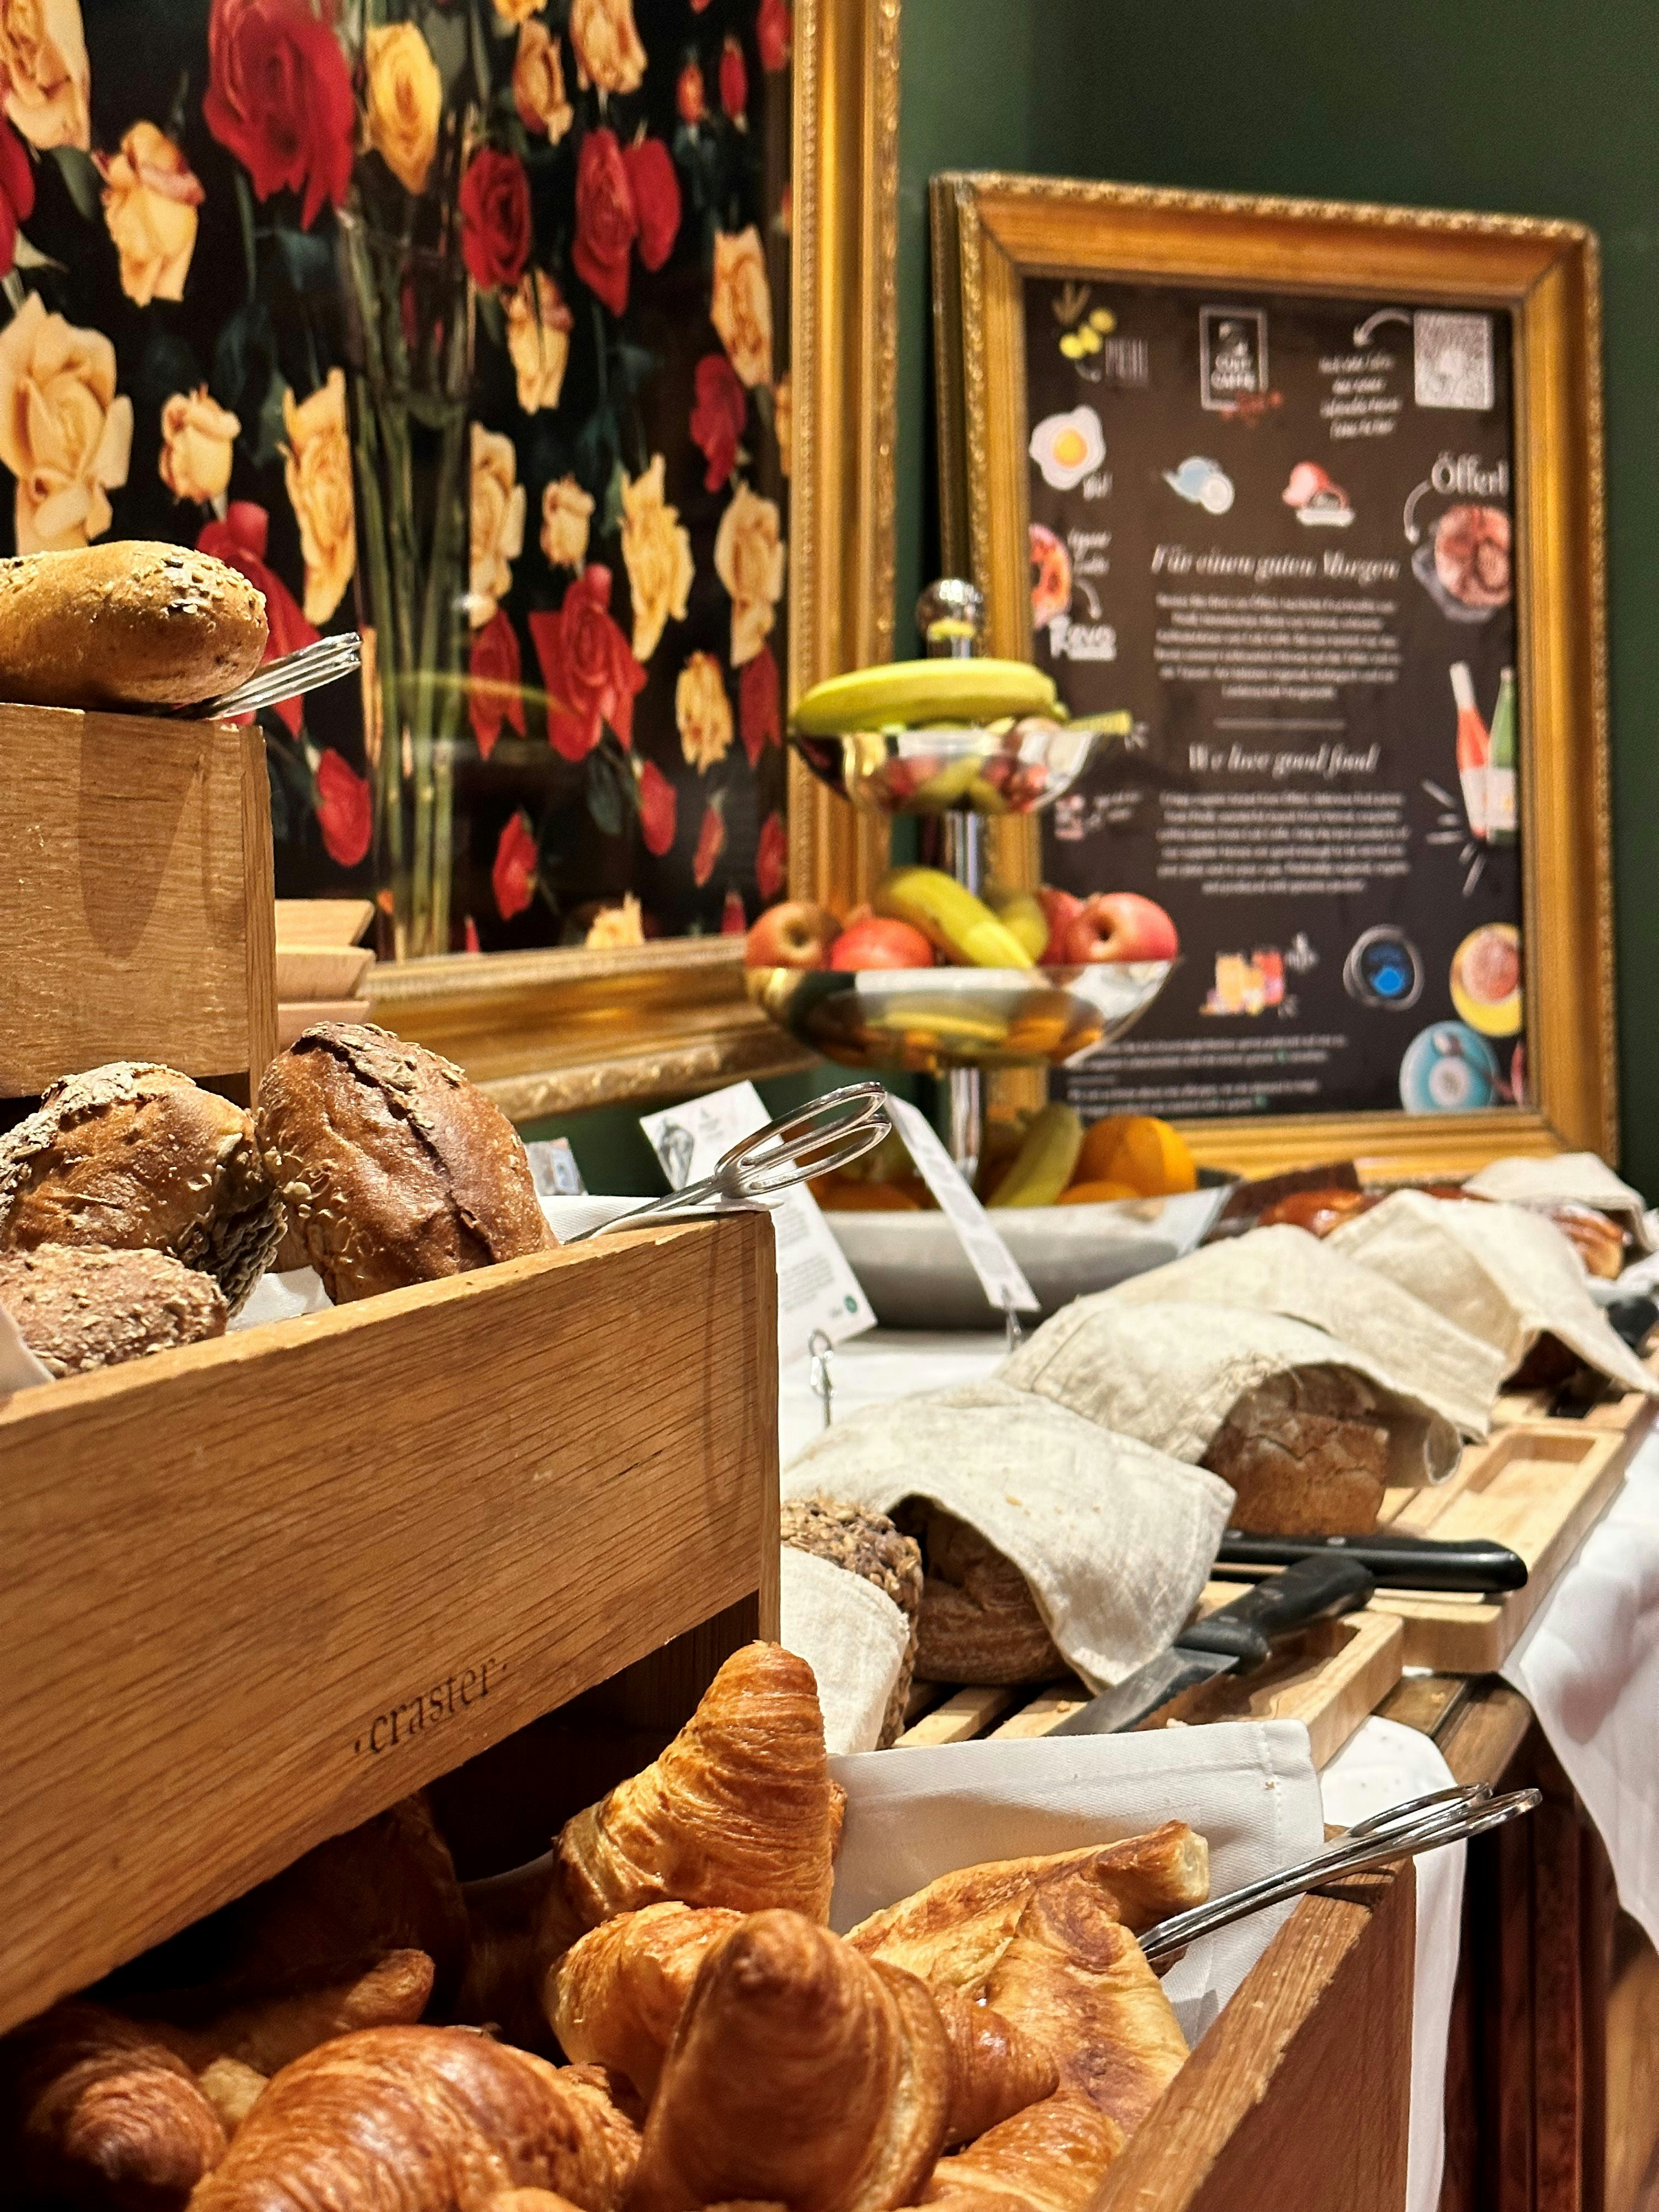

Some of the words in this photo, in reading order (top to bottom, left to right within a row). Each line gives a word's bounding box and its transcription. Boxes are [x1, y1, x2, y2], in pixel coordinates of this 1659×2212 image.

[1195, 548, 1256, 575] einen
[1254, 554, 1317, 584] guten
[1323, 549, 1401, 588] Morgen
[1189, 742, 1225, 772] We
[1227, 741, 1271, 772] love
[1271, 742, 1331, 780] good
[1323, 742, 1381, 780] food
